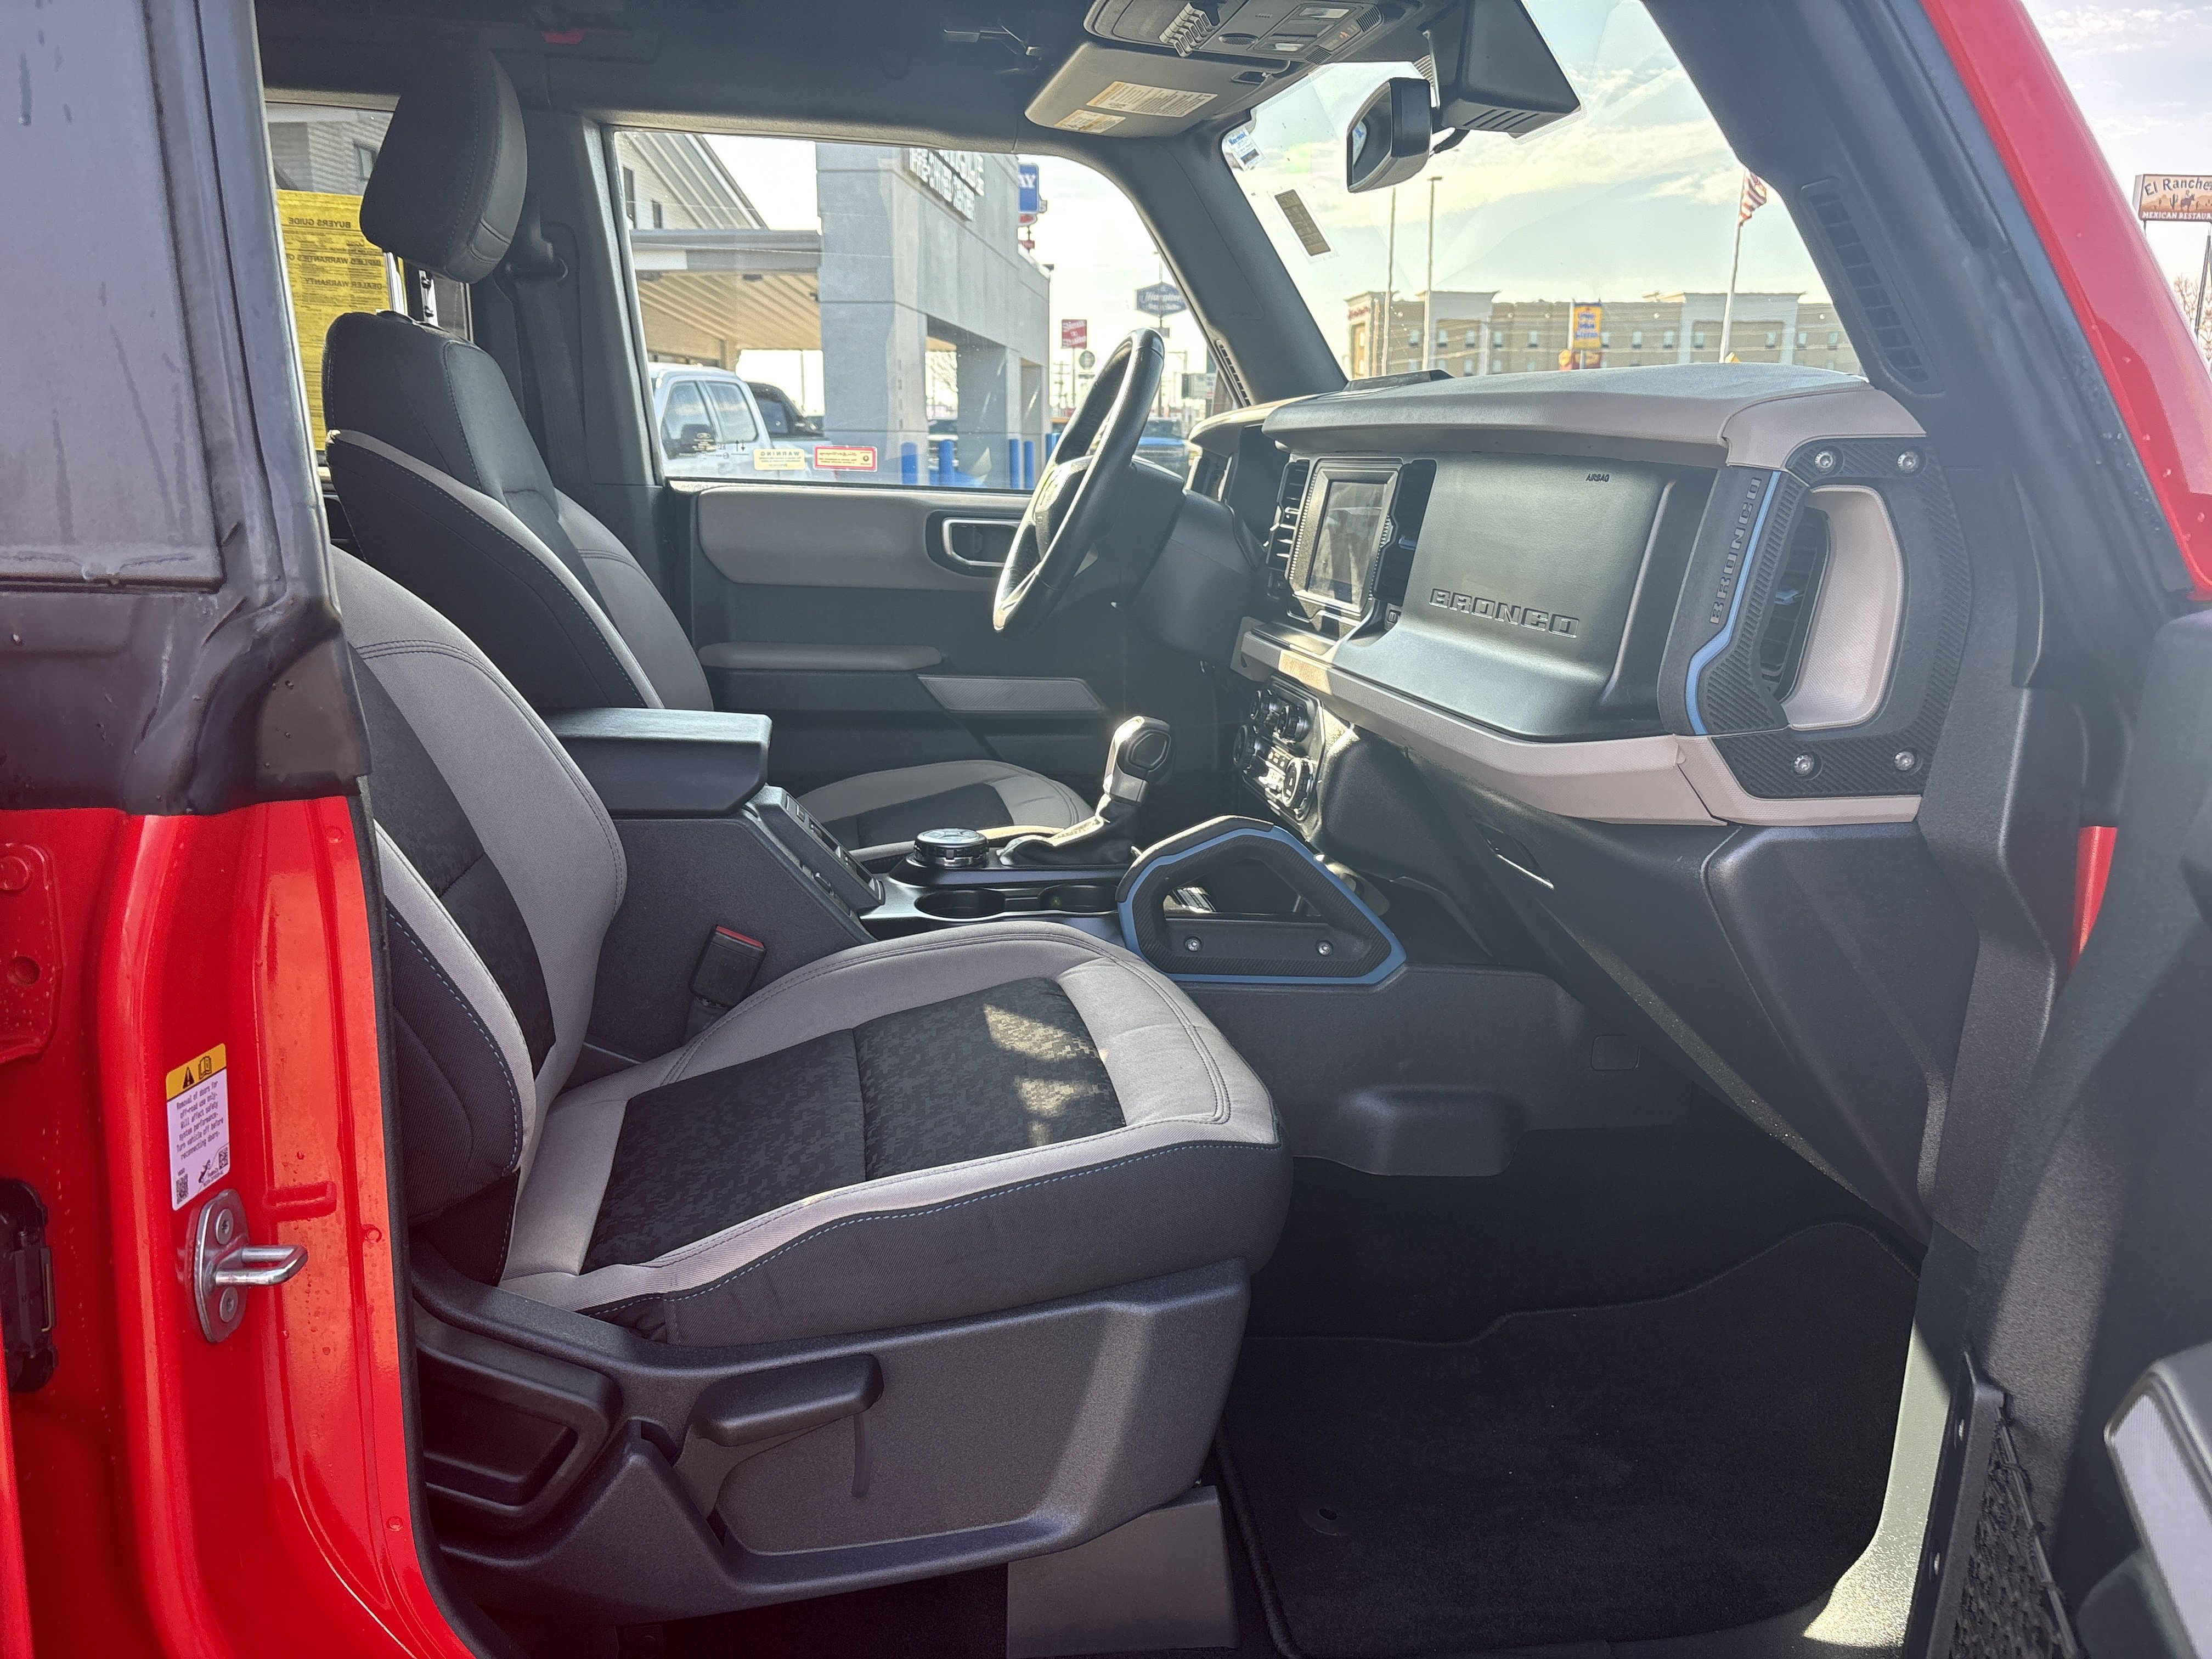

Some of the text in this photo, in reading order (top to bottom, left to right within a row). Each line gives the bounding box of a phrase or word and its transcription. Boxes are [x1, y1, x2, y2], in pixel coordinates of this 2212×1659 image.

[2144, 181, 2158, 196] El
[1585, 473, 1610, 482] AIRBAG
[1709, 477, 1762, 624] BRONCO
[1429, 588, 1580, 639] BRONCO
